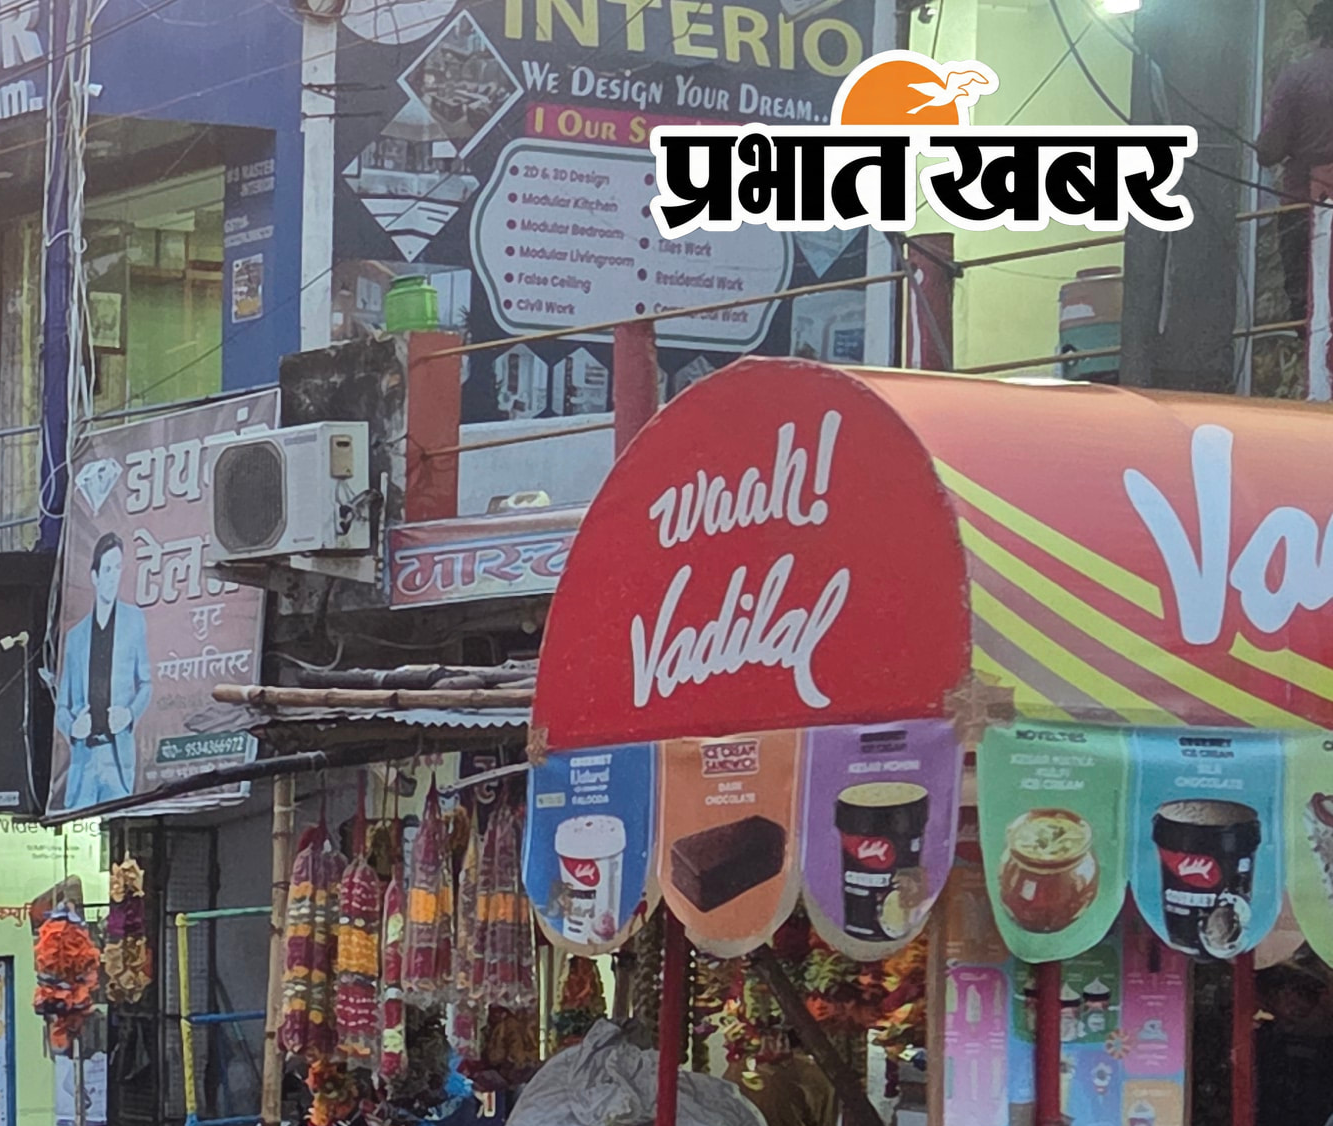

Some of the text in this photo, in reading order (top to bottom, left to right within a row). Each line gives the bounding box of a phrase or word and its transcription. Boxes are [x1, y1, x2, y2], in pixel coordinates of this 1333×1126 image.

[570, 171, 610, 188] Design
[521, 192, 618, 214] Modular Kitchen
[520, 219, 624, 240] Modular Bedroom
[519, 245, 635, 268] Modular Livingroom
[684, 242, 712, 257] Work
[518, 272, 591, 294] False Ceiling
[655, 270, 744, 291] Residential Work
[545, 301, 575, 315] Work
[649, 410, 841, 547] waah!
[632, 553, 850, 707] Vadilal
